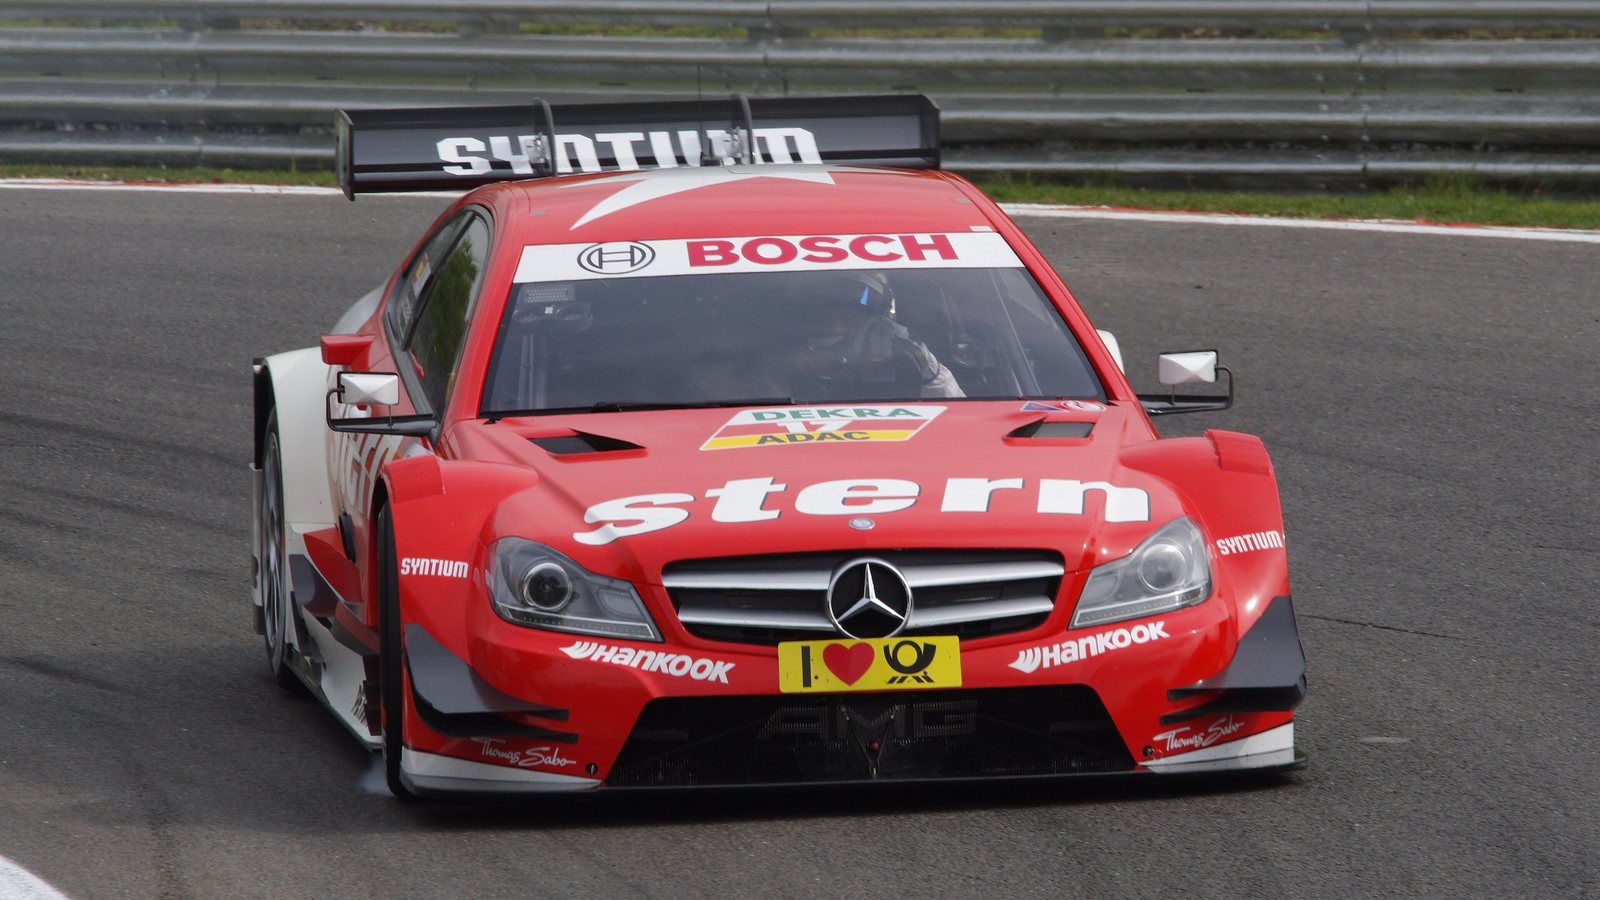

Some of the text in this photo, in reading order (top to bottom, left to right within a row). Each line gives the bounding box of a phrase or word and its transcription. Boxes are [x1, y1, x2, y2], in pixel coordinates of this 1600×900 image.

[435, 127, 823, 176] SYNTIUM
[686, 233, 960, 268] BOSCH
[752, 408, 923, 421] DEKRA
[756, 431, 871, 446] ADAC
[573, 477, 1151, 545] stern
[1216, 530, 1283, 555] SYNTIUM
[400, 557, 469, 578] SYNTIUM
[470, 736, 577, 767] Thomas Sabo
